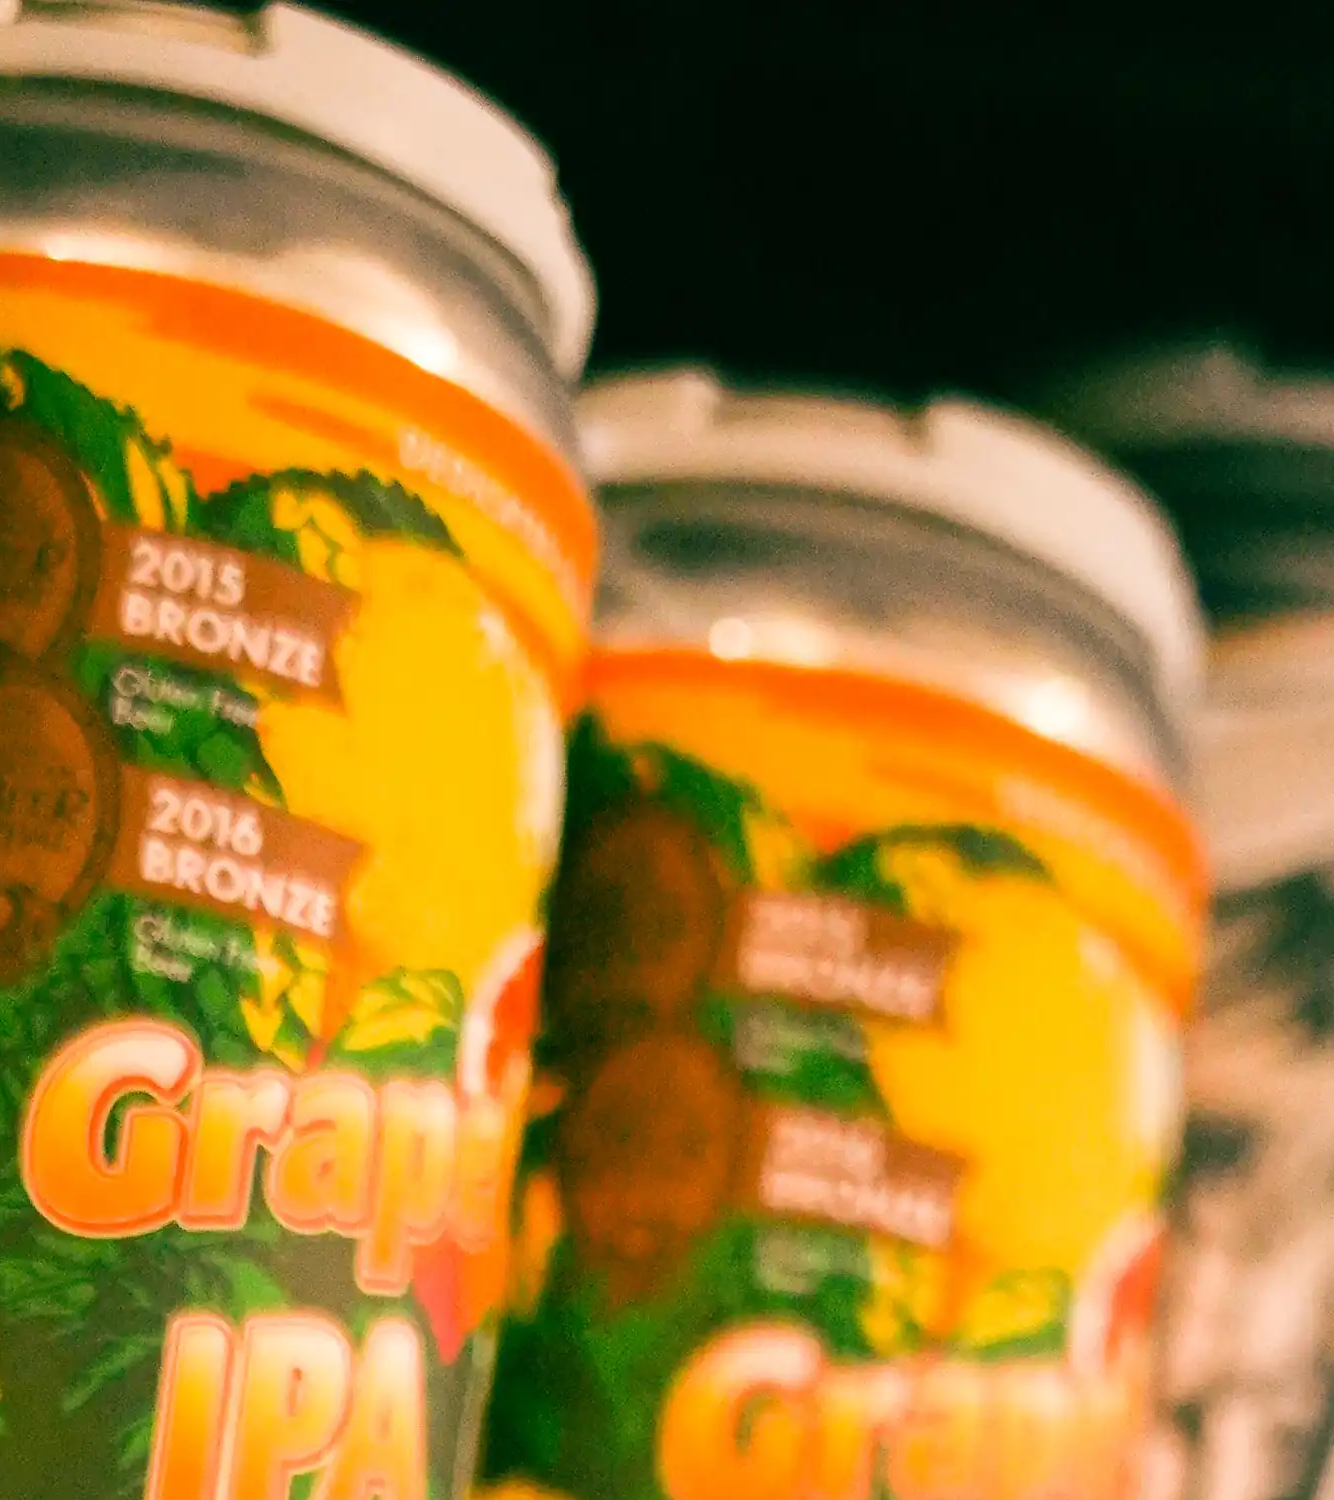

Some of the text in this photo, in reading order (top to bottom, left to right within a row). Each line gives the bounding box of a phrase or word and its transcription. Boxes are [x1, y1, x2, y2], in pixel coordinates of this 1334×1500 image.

[129, 537, 245, 606] 2015
[120, 589, 323, 688] BRONZE
[151, 788, 263, 857] 2016
[141, 836, 337, 938] BRONZE
